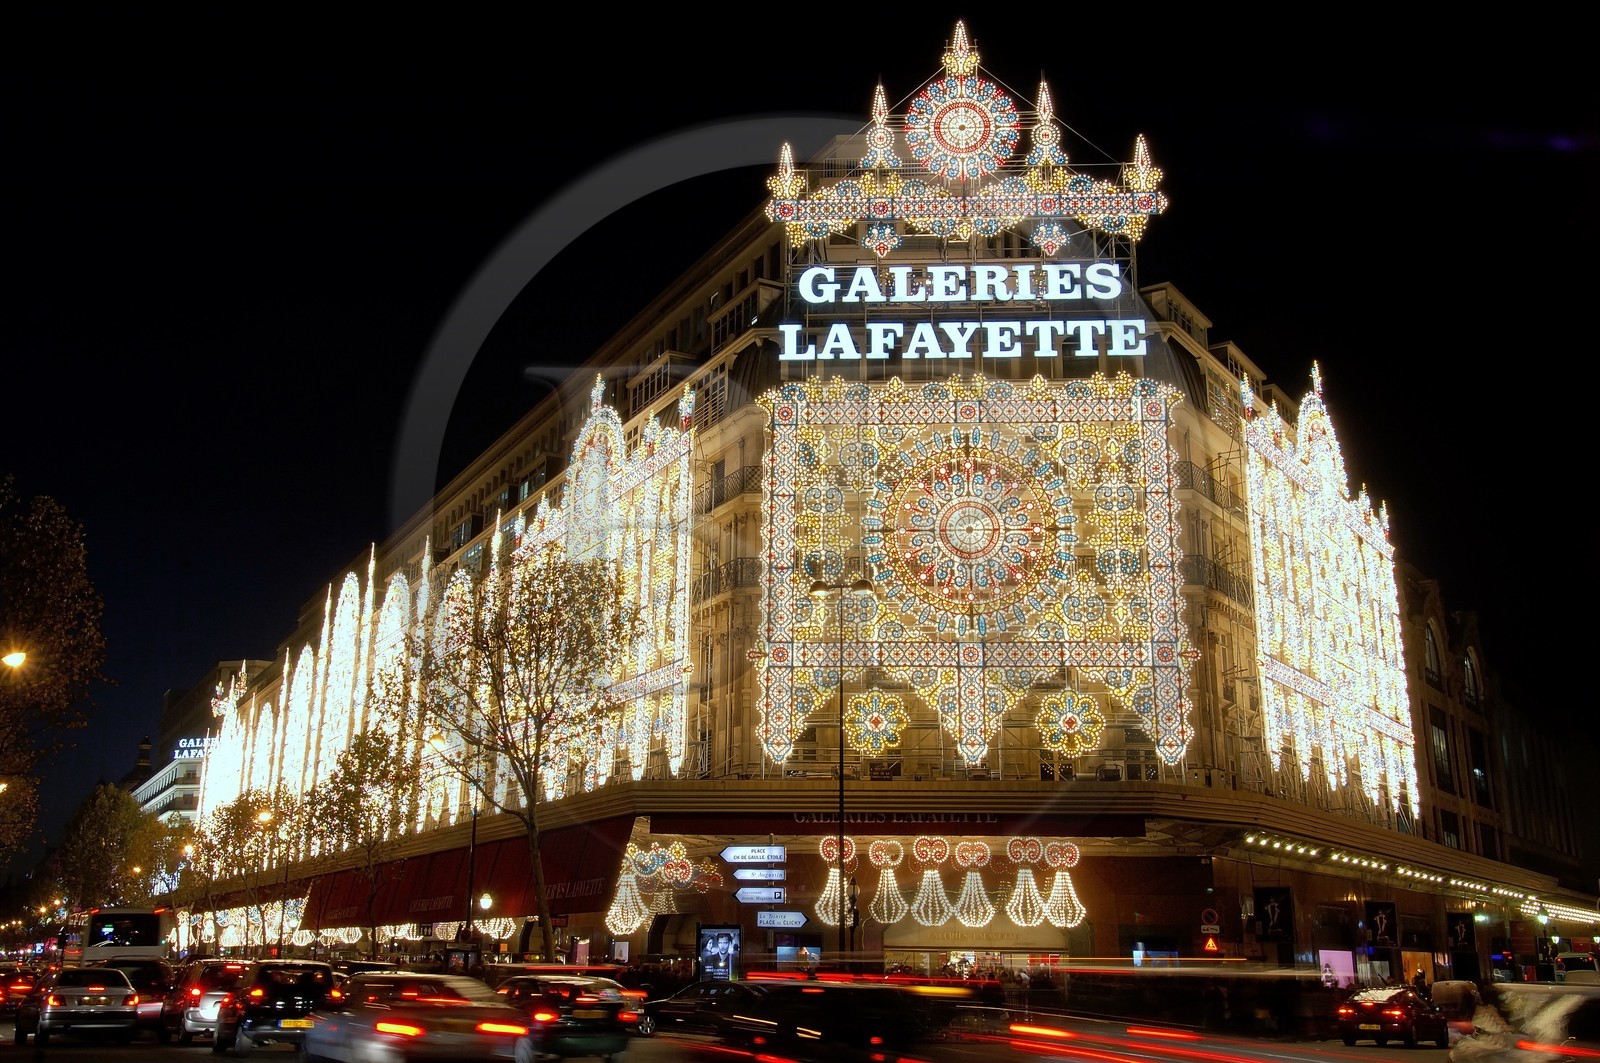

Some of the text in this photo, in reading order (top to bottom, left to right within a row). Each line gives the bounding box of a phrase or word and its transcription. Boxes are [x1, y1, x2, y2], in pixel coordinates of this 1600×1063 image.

[799, 262, 1122, 304] GALERIES
[778, 319, 1147, 361] LAFAYETTE
[793, 812, 886, 824] GALERIES
